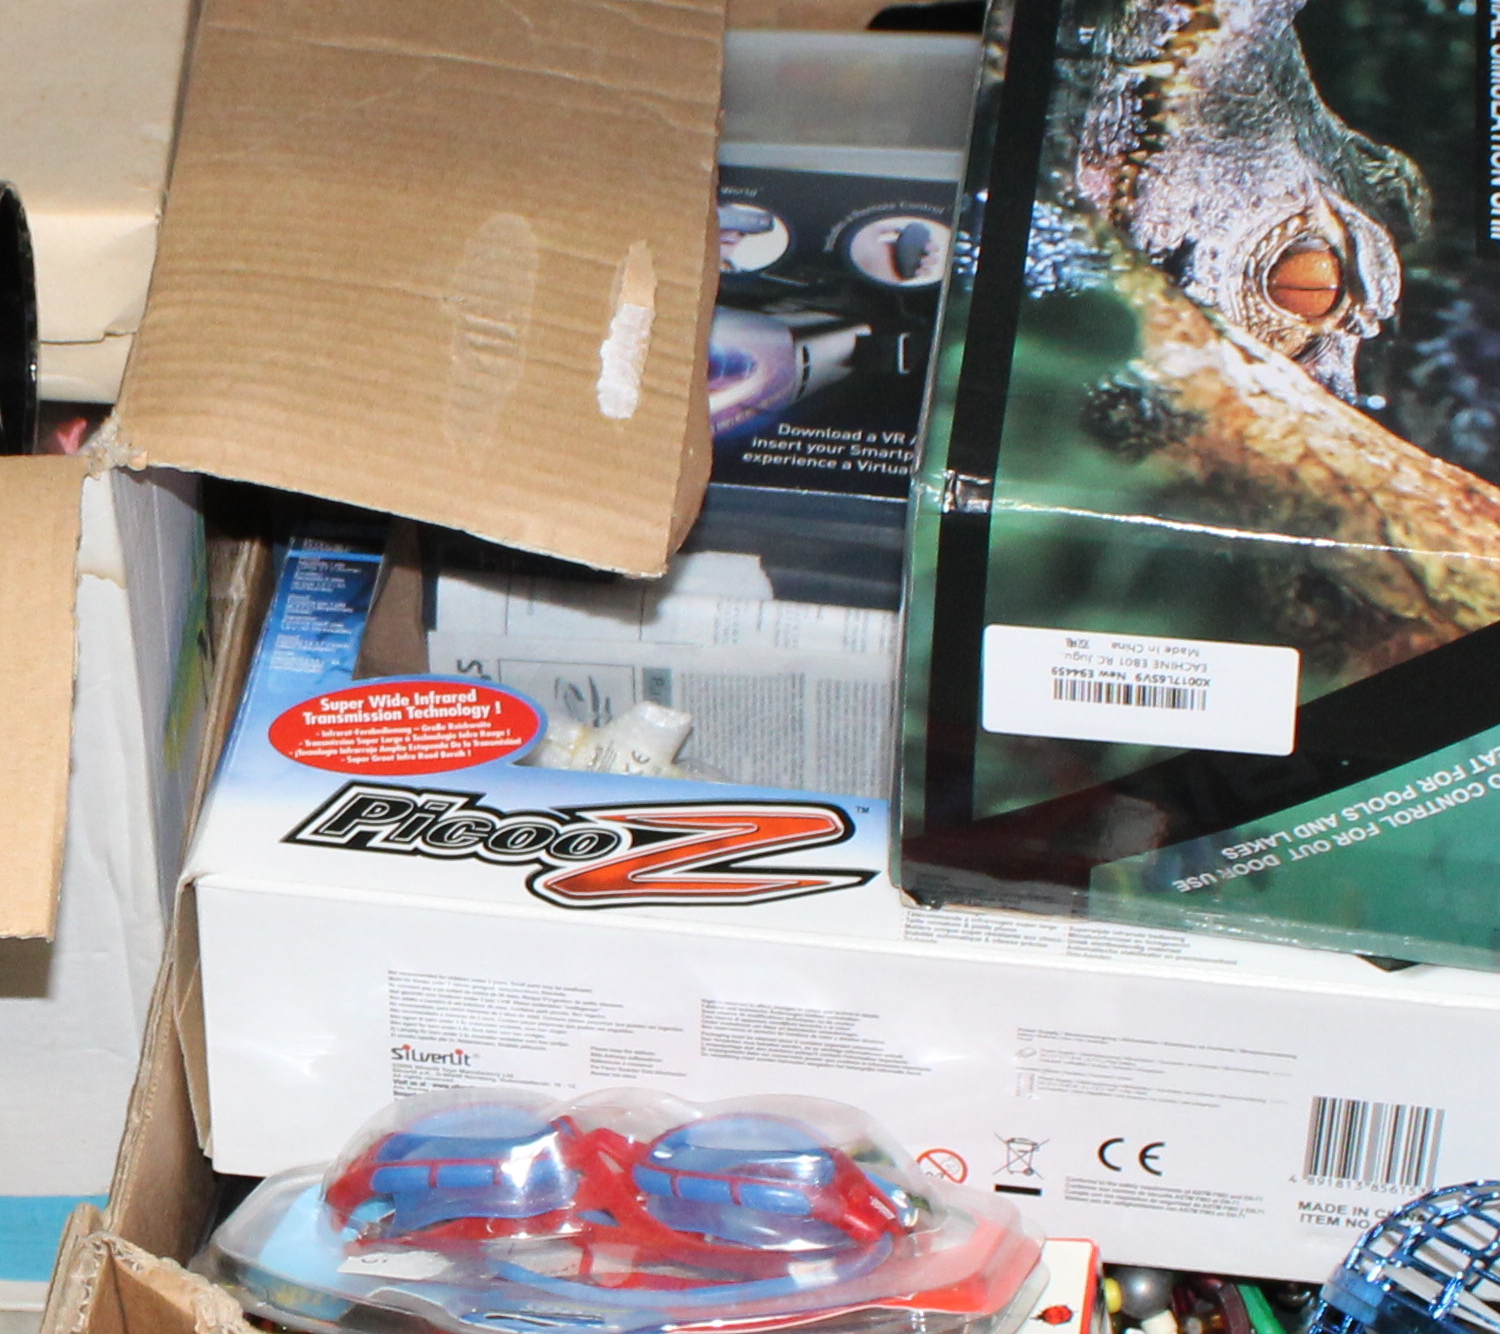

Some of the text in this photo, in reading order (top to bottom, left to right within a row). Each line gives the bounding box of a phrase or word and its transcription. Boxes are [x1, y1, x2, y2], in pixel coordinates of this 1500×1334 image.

[777, 422, 862, 442] Download
[866, 432, 877, 442] a
[881, 430, 906, 445] VR
[751, 435, 914, 462] insert your Smartp
[742, 451, 837, 469] experience
[855, 459, 912, 476] Virtua
[1110, 641, 1144, 654] China
[1163, 646, 1201, 658] Made
[1097, 655, 1115, 667] RC
[1152, 659, 1209, 673] EACHINE
[1098, 670, 1127, 681] New
[319, 689, 478, 713] Super Wide Infrared
[302, 704, 403, 725] Transmission
[407, 703, 491, 721] Technology
[1415, 763, 1466, 792] FOR
[1340, 784, 1417, 823] POOLS
[1377, 780, 1487, 829] CONTROL
[1291, 813, 1340, 841] AND
[1333, 820, 1379, 848] FOR
[1220, 830, 1294, 862] LAKES
[1286, 837, 1332, 862] OUT
[1216, 851, 1282, 881] DOOR
[1171, 870, 1218, 894] USE
[1297, 1200, 1428, 1223] MADE IN CNA
[1299, 1213, 1341, 1226] ITEM
